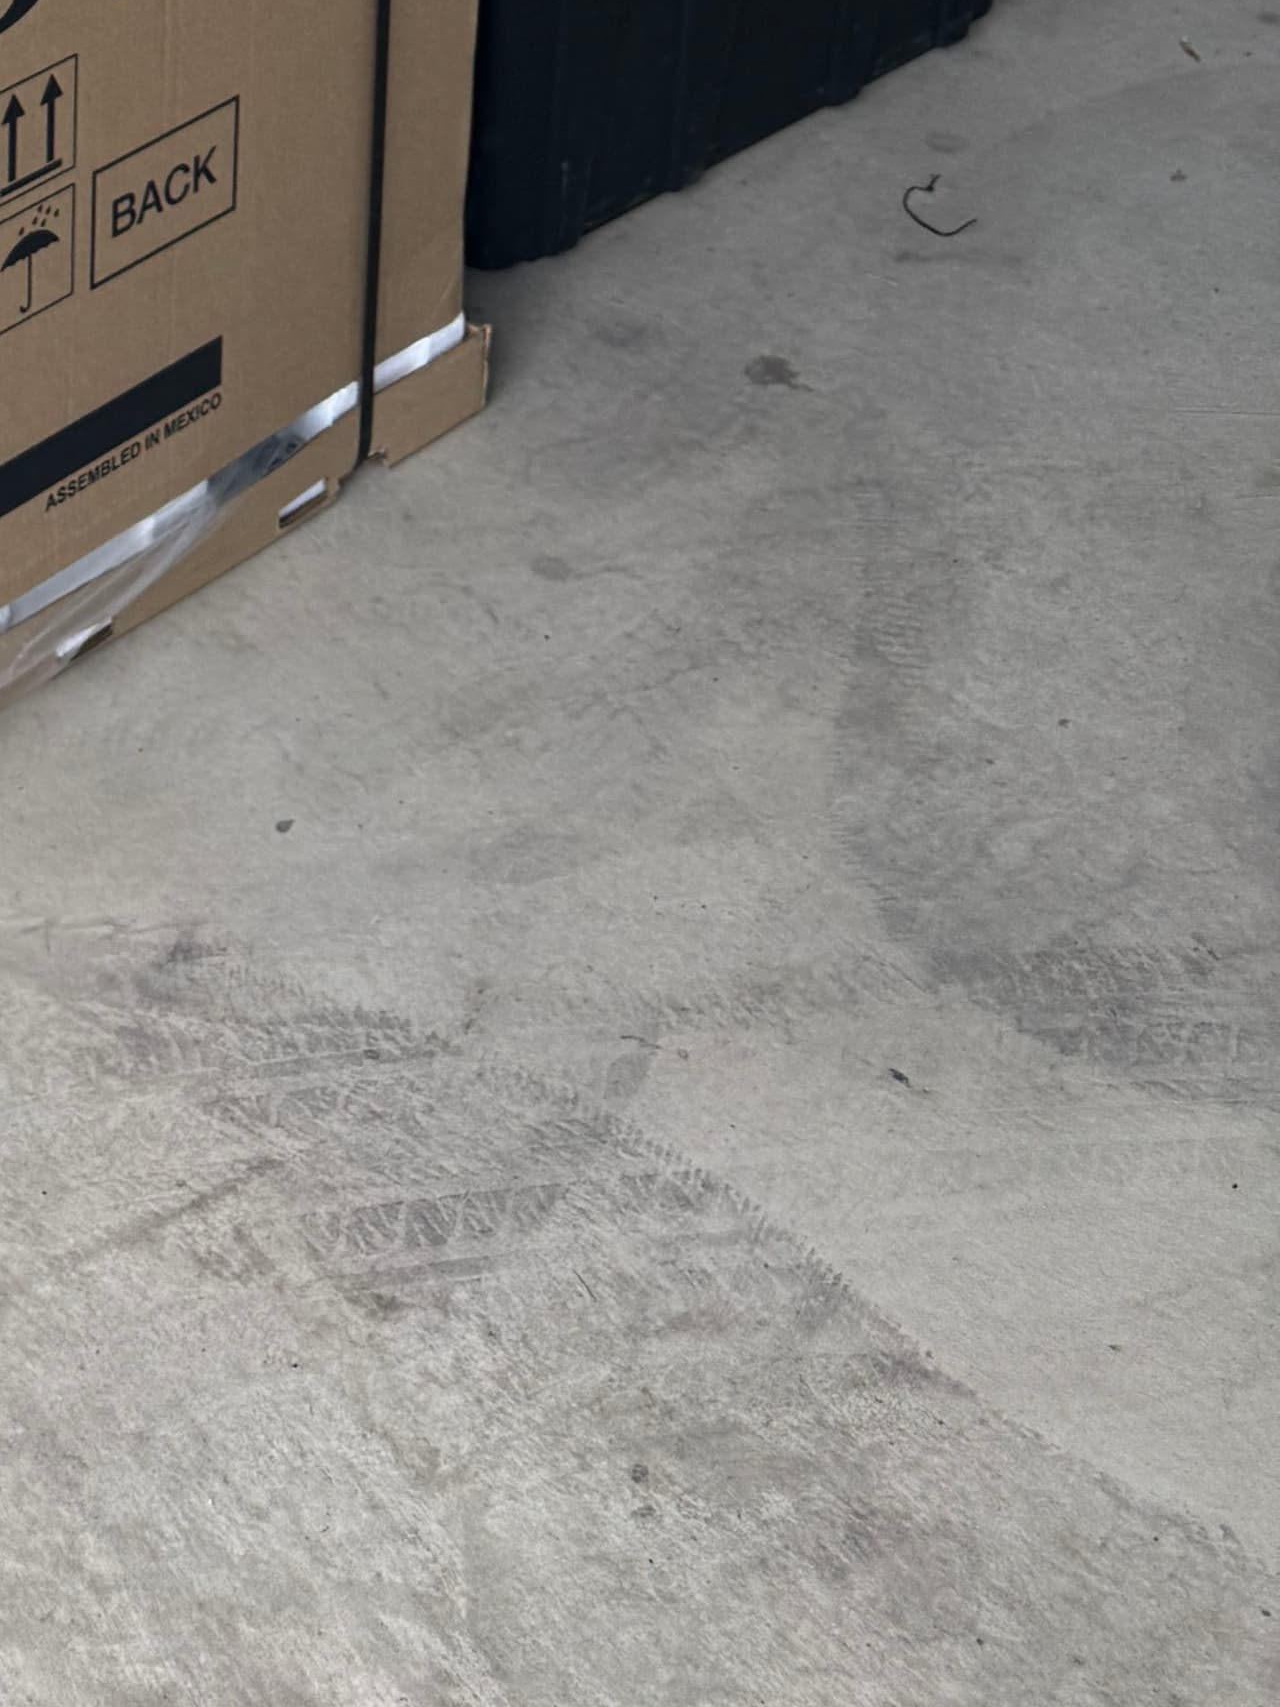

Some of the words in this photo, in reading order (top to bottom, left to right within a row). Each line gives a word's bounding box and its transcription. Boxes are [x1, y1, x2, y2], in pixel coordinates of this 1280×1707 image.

[110, 144, 218, 238] BACK
[44, 441, 141, 514] ASSEMBLED
[145, 430, 161, 452] IN
[163, 391, 223, 439] MEXICO
